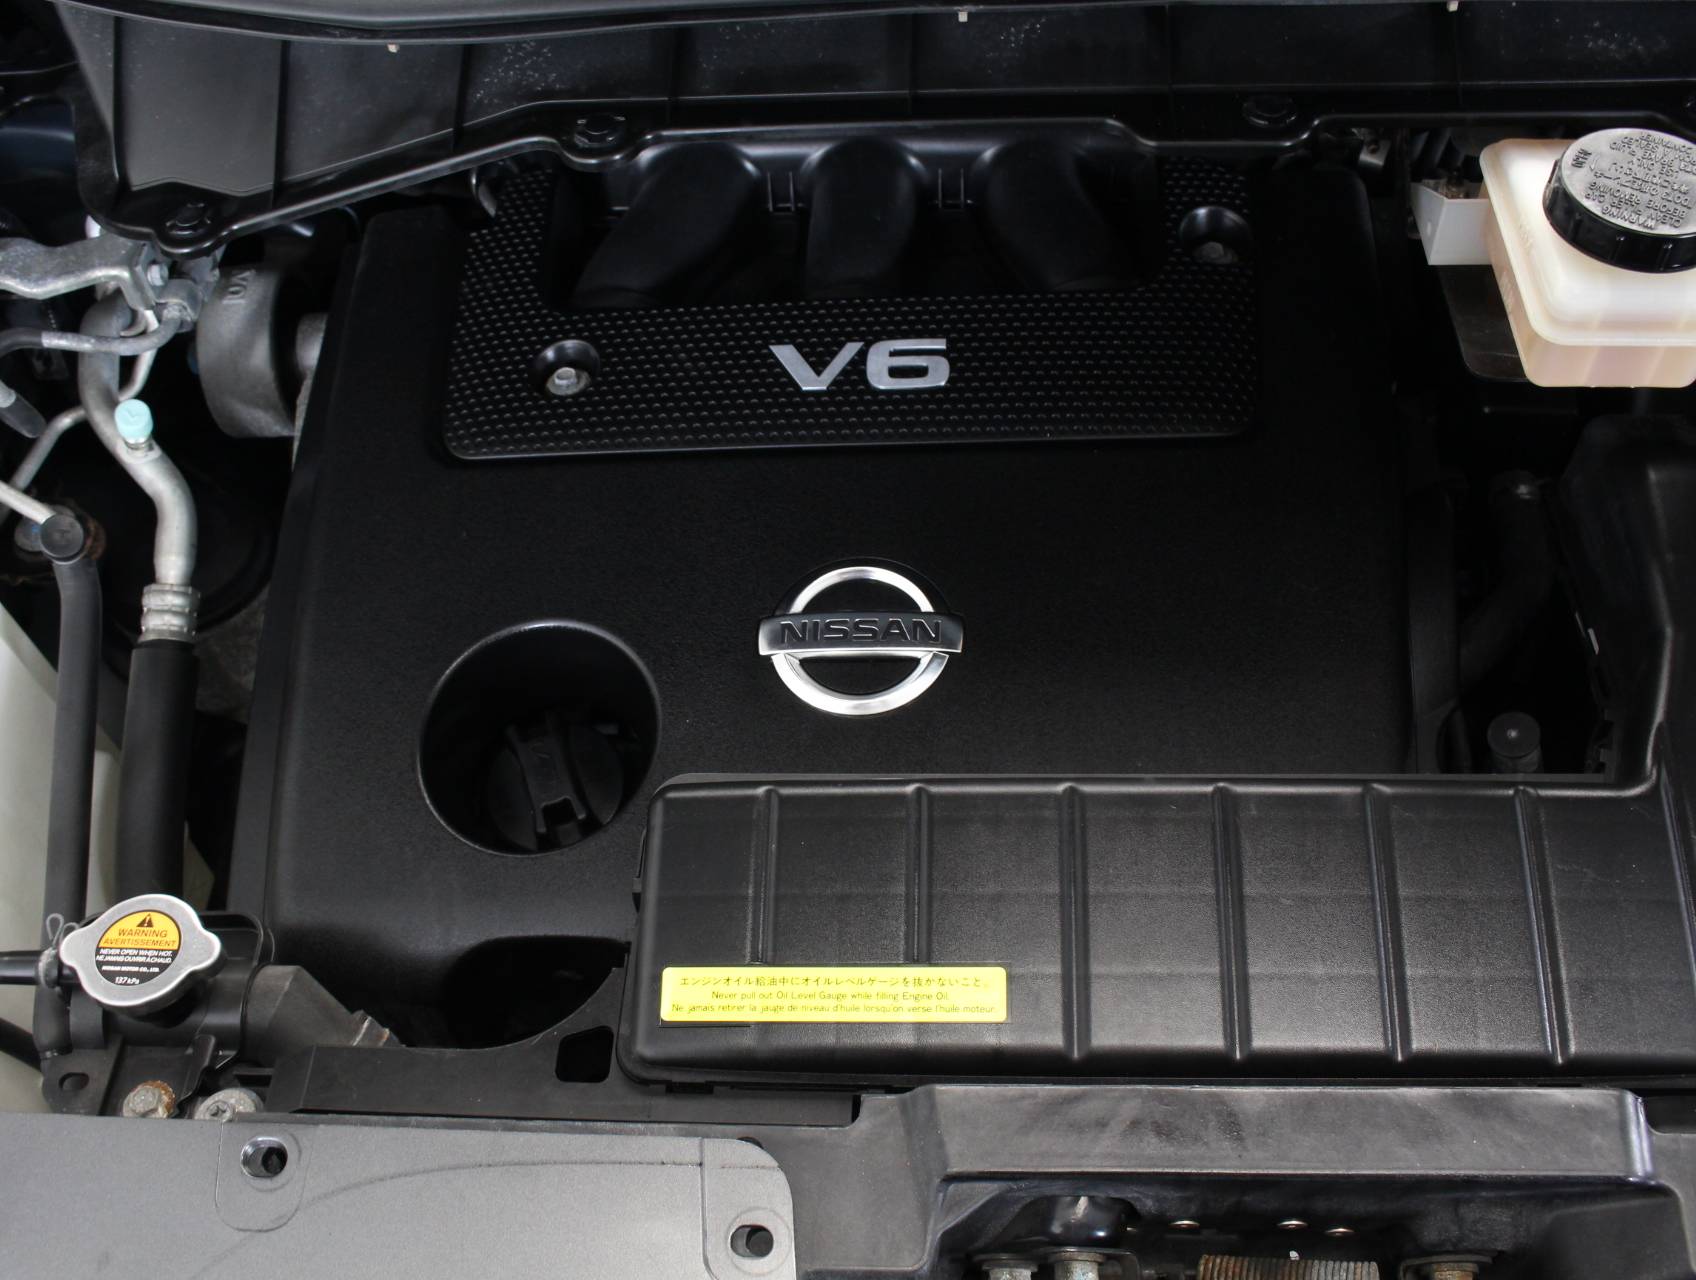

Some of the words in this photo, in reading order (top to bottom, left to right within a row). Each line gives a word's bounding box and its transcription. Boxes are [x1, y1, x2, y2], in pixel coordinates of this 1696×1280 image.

[1588, 181, 1641, 205] REMOVING
[1602, 205, 1656, 230] WARNING
[1646, 199, 1688, 218] BEFORE
[1650, 210, 1683, 228] CLEAN
[768, 338, 950, 391] V6
[779, 617, 943, 644] NISSAN
[118, 928, 168, 937] WARNING
[103, 938, 176, 947] AVERTISSEMENT
[139, 949, 158, 957] WHEN
[711, 991, 738, 1000] Never
[741, 991, 756, 1002] pull
[759, 992, 773, 1000] out
[776, 990, 788, 1000] Oil
[791, 991, 816, 1000] Level
[819, 991, 847, 1002] Gauge
[851, 991, 873, 1000] while
[876, 991, 899, 1002] filling
[903, 991, 933, 1003] Engine
[672, 1004, 685, 1012] Ne
[687, 1004, 715, 1014] jamais
[718, 1004, 745, 1012] retirer
[788, 1004, 799, 1012] de
